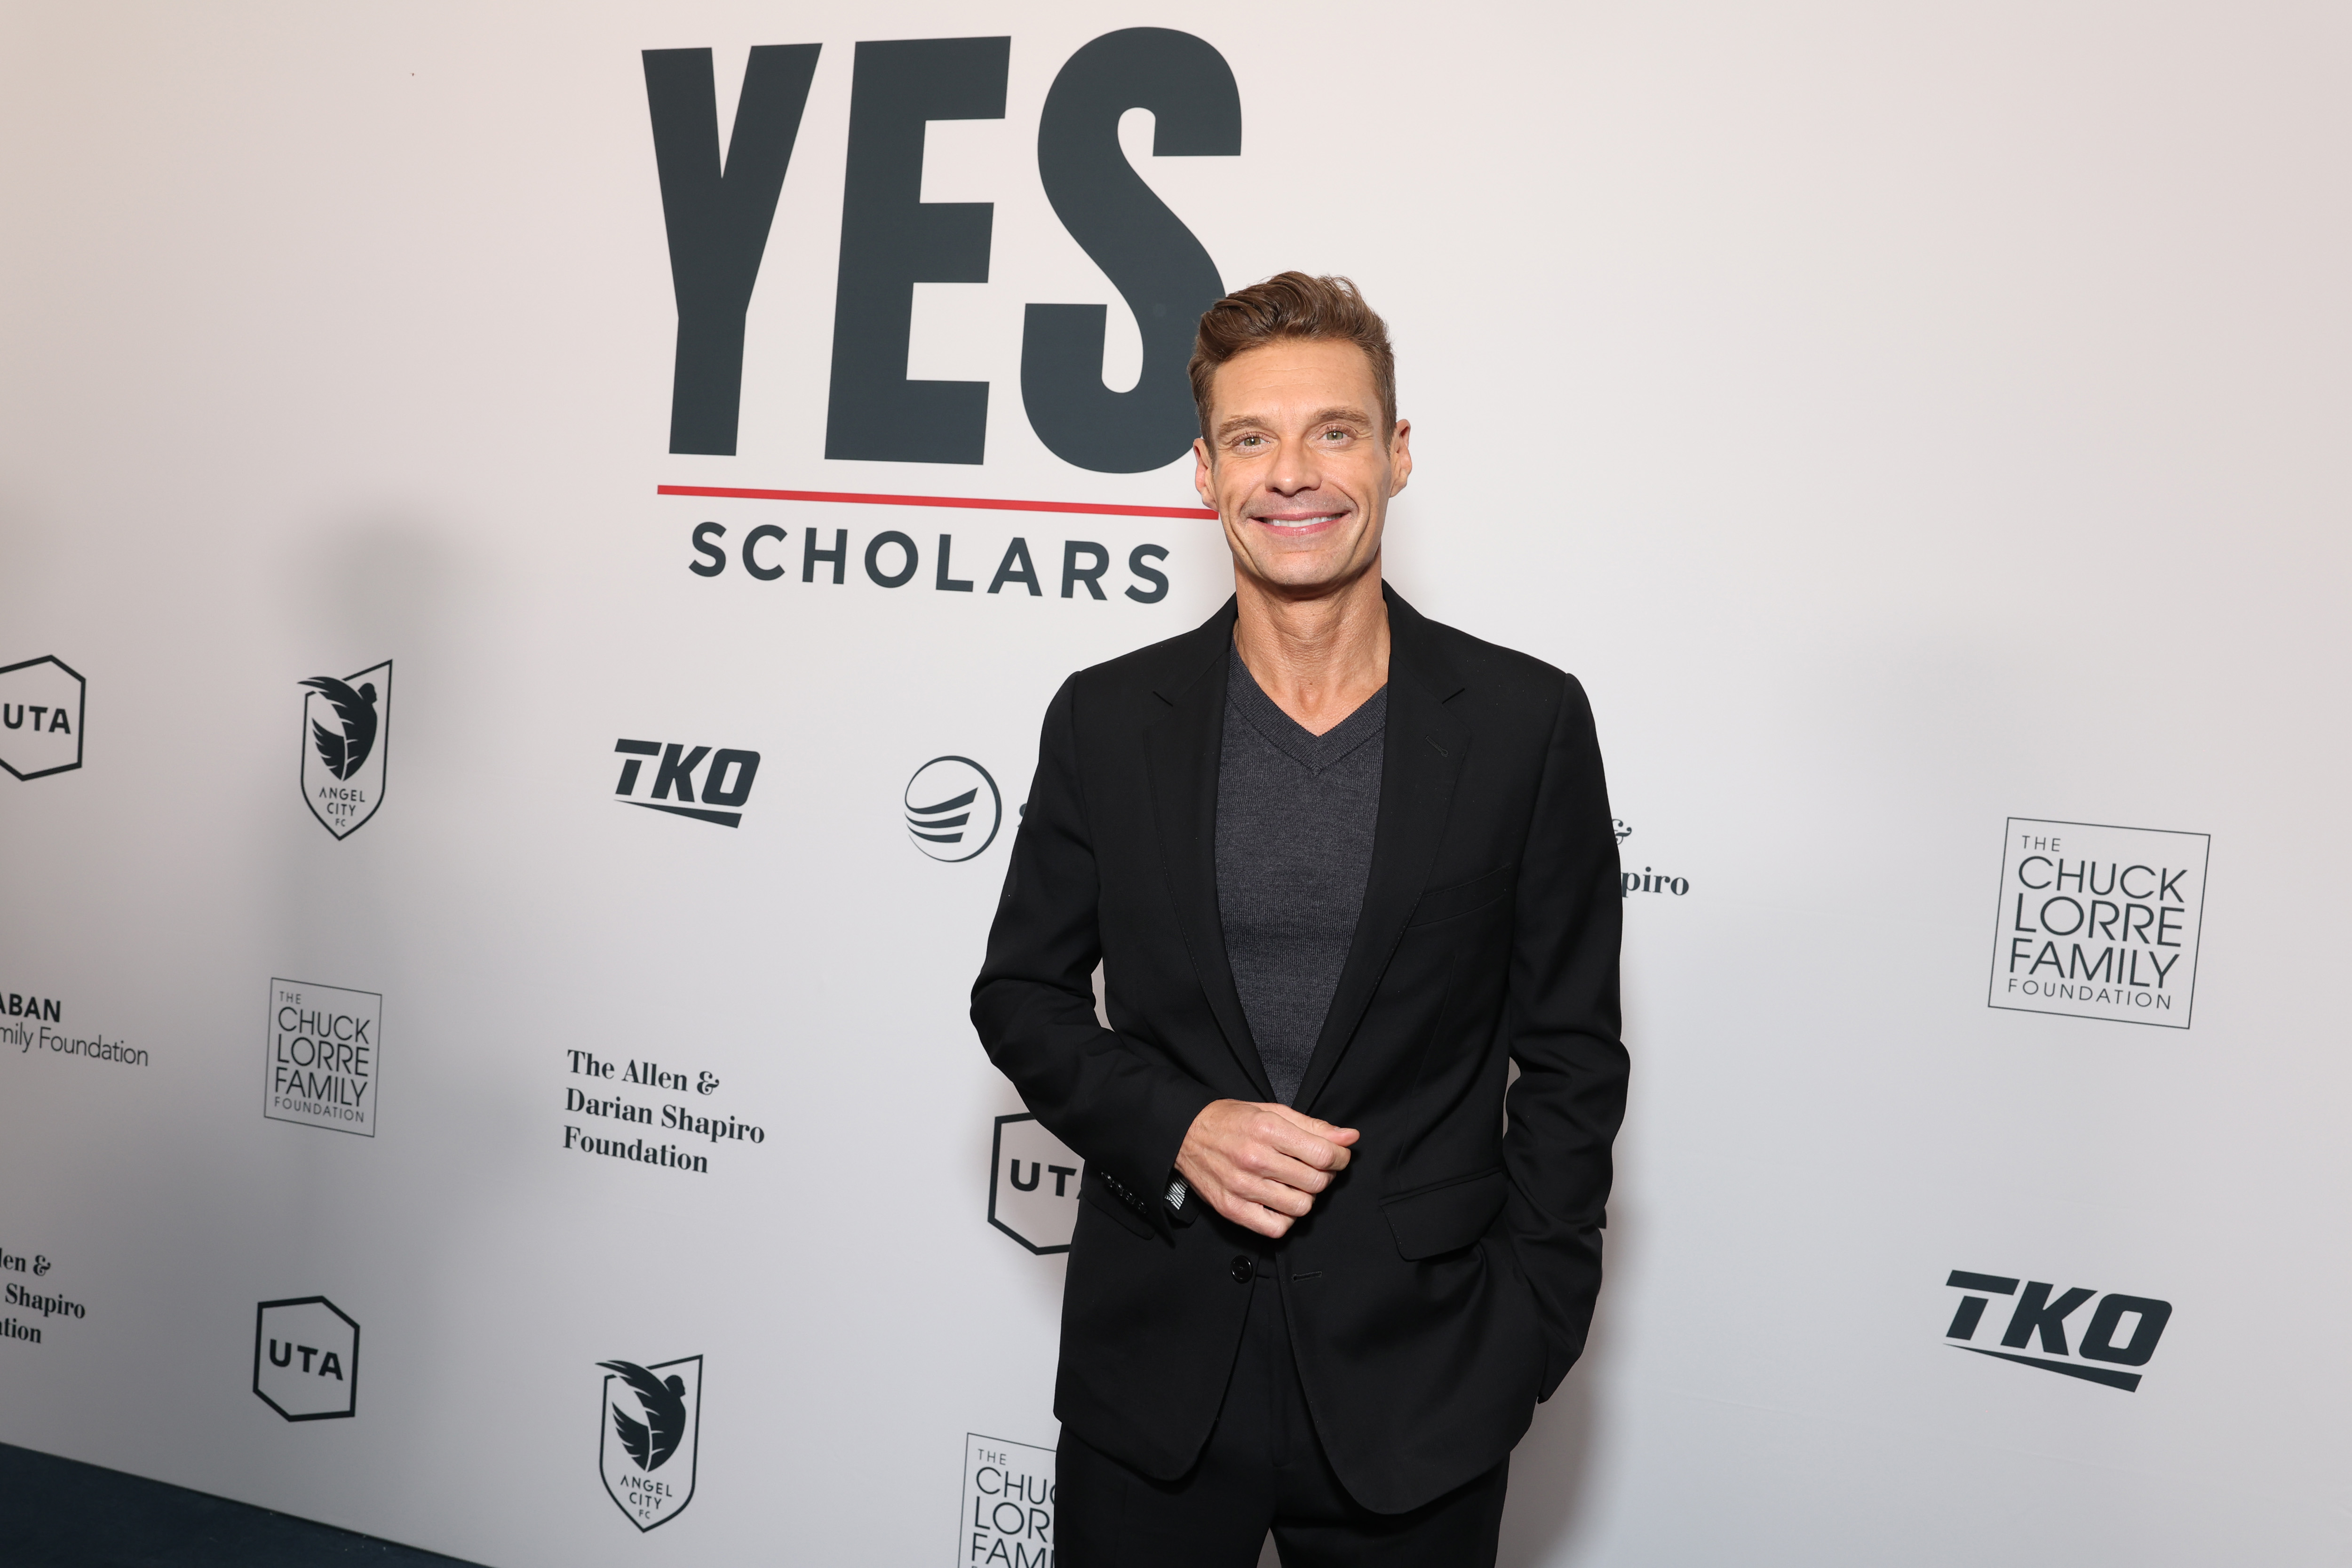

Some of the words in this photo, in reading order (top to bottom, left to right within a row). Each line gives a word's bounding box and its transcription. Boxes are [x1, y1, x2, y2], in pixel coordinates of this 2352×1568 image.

[642, 26, 1242, 474] YES
[688, 521, 1170, 604] SCHOLARS
[3, 703, 71, 734] UTA
[614, 738, 761, 807] TKO
[319, 787, 366, 803] ANGEL
[326, 802, 356, 817] CITY
[335, 818, 346, 827] FC
[2022, 835, 2061, 852] THE
[1621, 866, 1690, 899] piro
[2018, 855, 2188, 903] CHUCK
[2015, 892, 2185, 947] LORRE
[2010, 937, 2180, 989] FAMILY
[280, 991, 302, 1004] THE
[2008, 978, 2171, 1010] FOUNDATION
[0, 1022, 34, 1053] mily
[39, 1026, 148, 1067] Foundation
[278, 1006, 370, 1045] CHUCK
[277, 1033, 370, 1077] LORRE
[567, 1049, 615, 1079] The
[621, 1059, 688, 1091] Allen
[697, 1071, 720, 1095] &
[275, 1066, 368, 1107] FAMILY
[274, 1096, 365, 1123] FOUNDATION
[565, 1087, 652, 1125] Darian
[661, 1104, 765, 1144] Shapiro
[563, 1125, 708, 1173] Foundation
[1010, 1159, 1082, 1200] UT
[32, 1255, 51, 1276] &
[5, 1283, 86, 1319] Shapiro
[1946, 1269, 2173, 1367] TKO
[269, 1338, 343, 1381] UTA
[978, 1449, 1007, 1465] THE
[620, 1475, 673, 1497] ANGEL
[629, 1492, 662, 1510] CITY
[976, 1467, 1056, 1505] CHU
[639, 1509, 651, 1519] FC
[974, 1496, 1054, 1544] LOR
[971, 1532, 1055, 1568] FAMI
